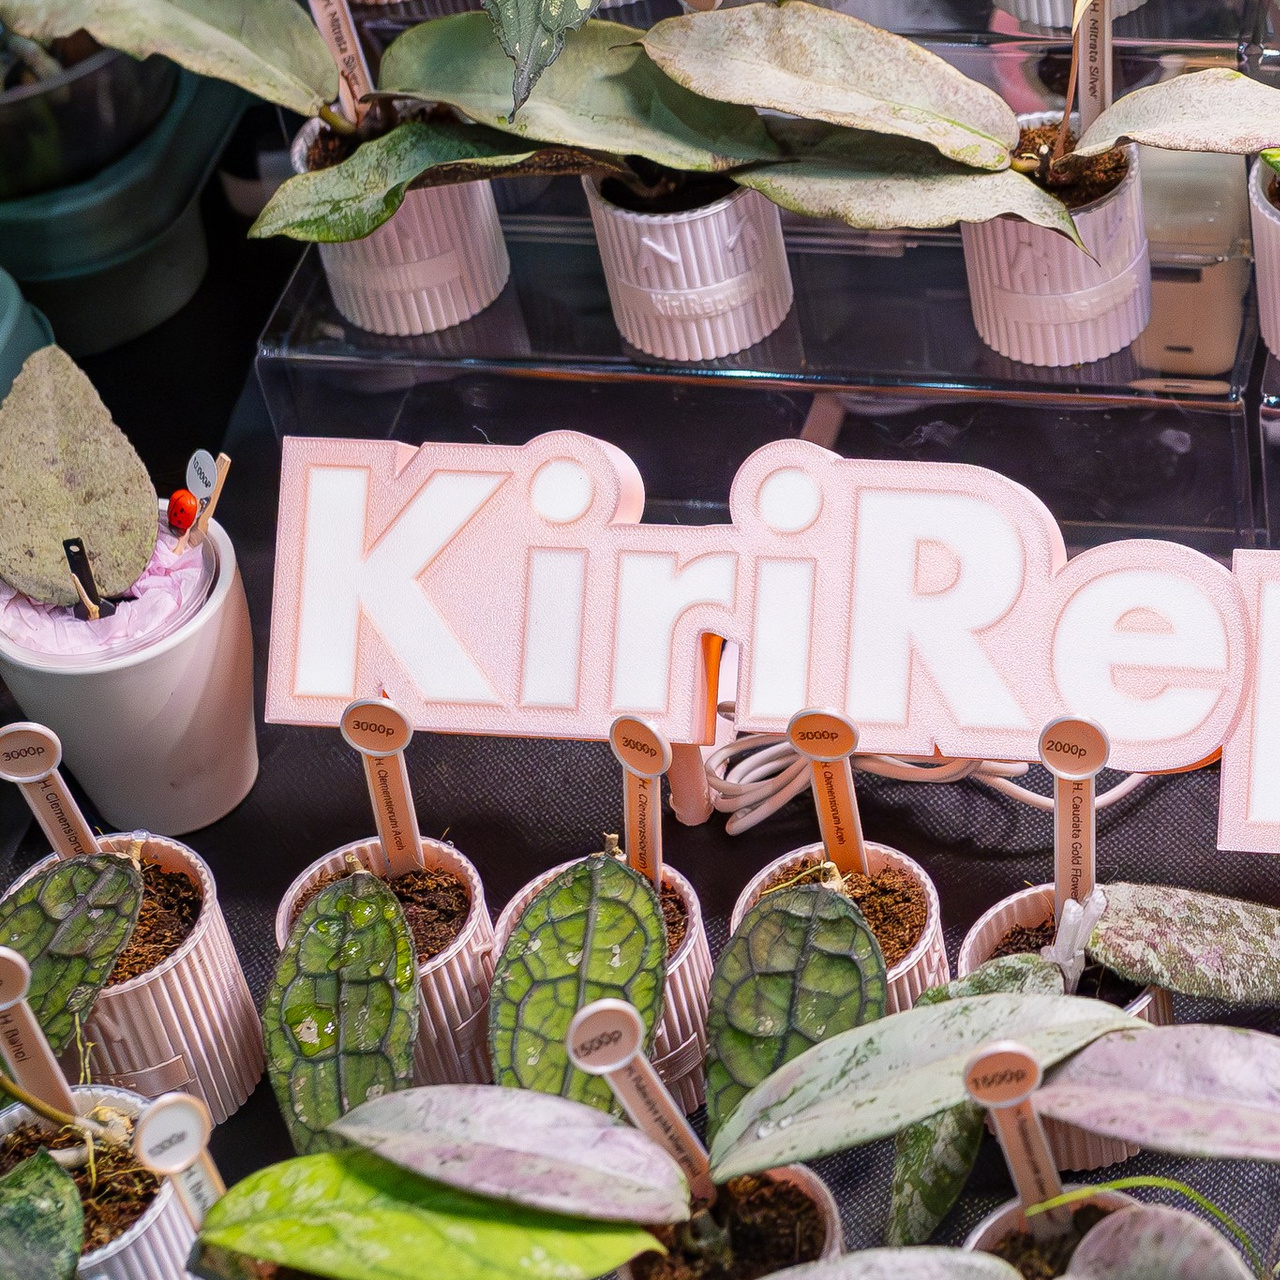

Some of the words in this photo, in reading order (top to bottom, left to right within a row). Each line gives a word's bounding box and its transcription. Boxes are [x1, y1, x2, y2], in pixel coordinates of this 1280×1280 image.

[1087, 64, 1100, 100] Silver
[352, 720, 395, 737] 3000p
[797, 730, 839, 744] 3000p
[2, 746, 45, 763] 3000p
[622, 735, 658, 758] 3000p
[1045, 740, 1087, 759] 2000p
[1069, 795, 1084, 839] Caudata
[391, 828, 407, 852] Aceh
[833, 825, 847, 846] Aceh
[1069, 840, 1083, 866] Gold
